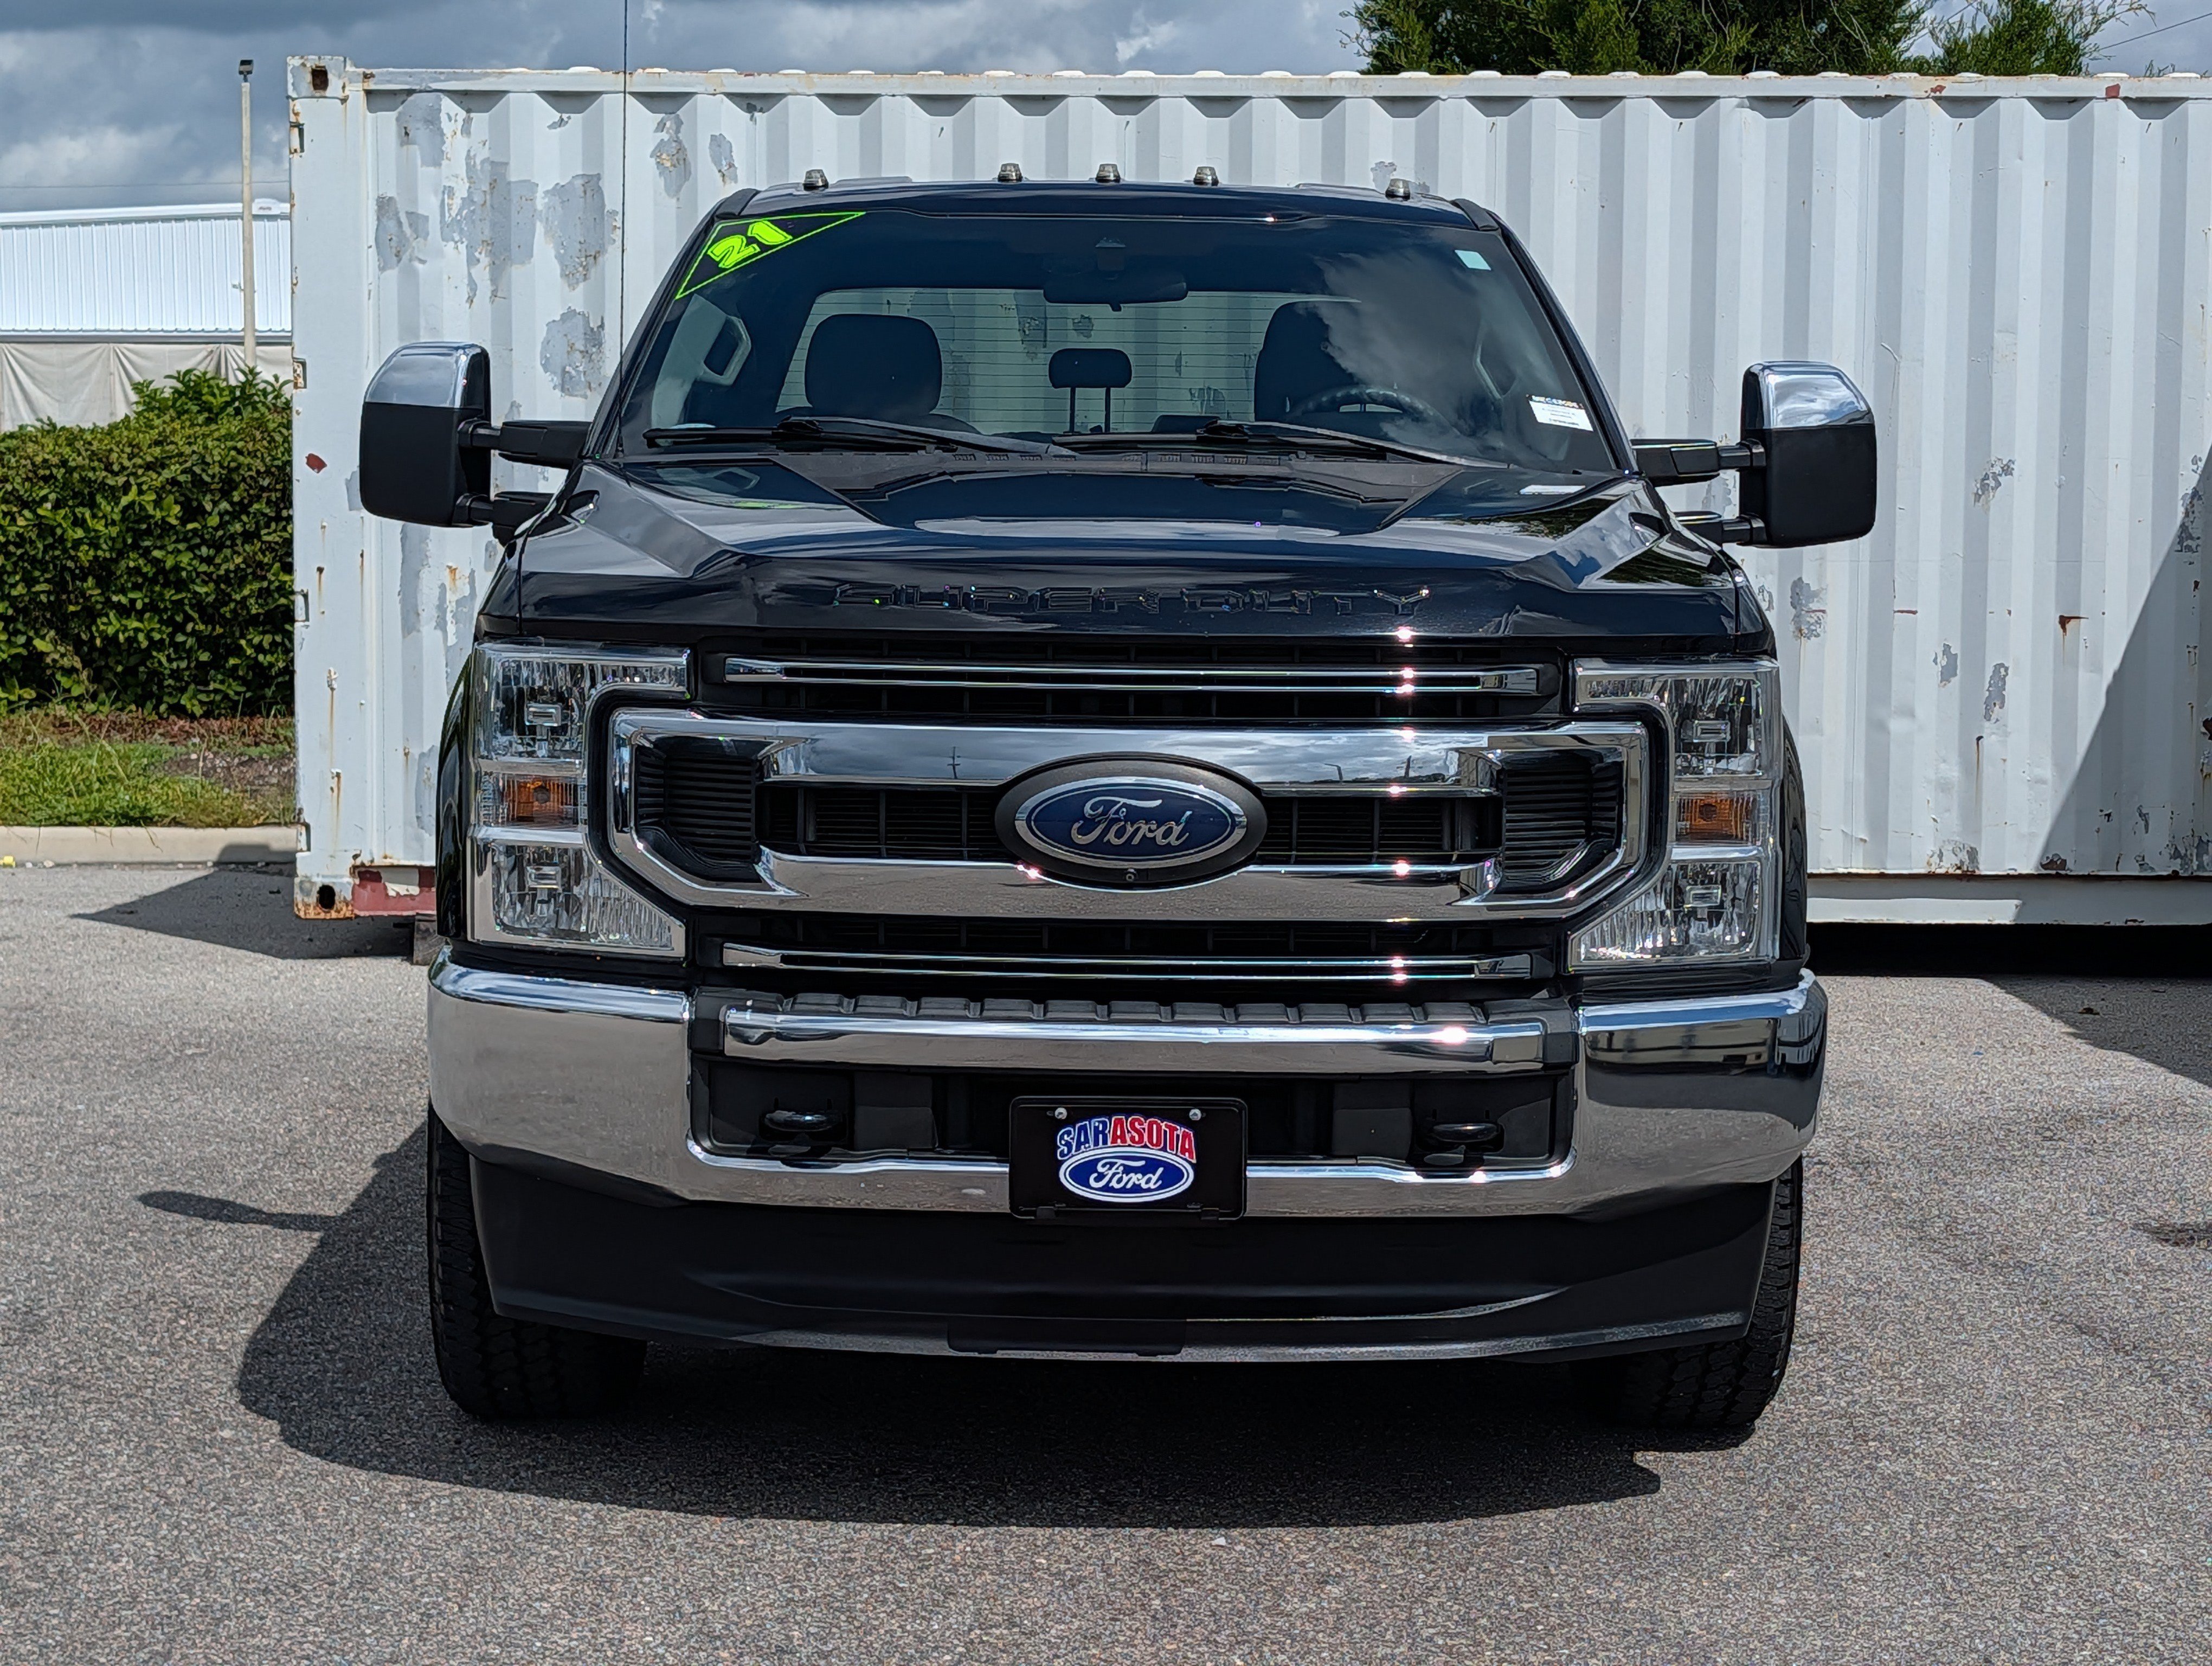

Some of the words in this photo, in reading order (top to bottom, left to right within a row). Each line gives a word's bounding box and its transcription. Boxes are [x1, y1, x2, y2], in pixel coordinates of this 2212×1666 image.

[707, 220, 793, 268] 21
[833, 584, 1160, 614] SUPER
[1181, 586, 1433, 616] DUTY
[1071, 796, 1192, 845] Ford
[1057, 1116, 1197, 1163] SARASOTA
[1090, 1159, 1163, 1189] Ford
